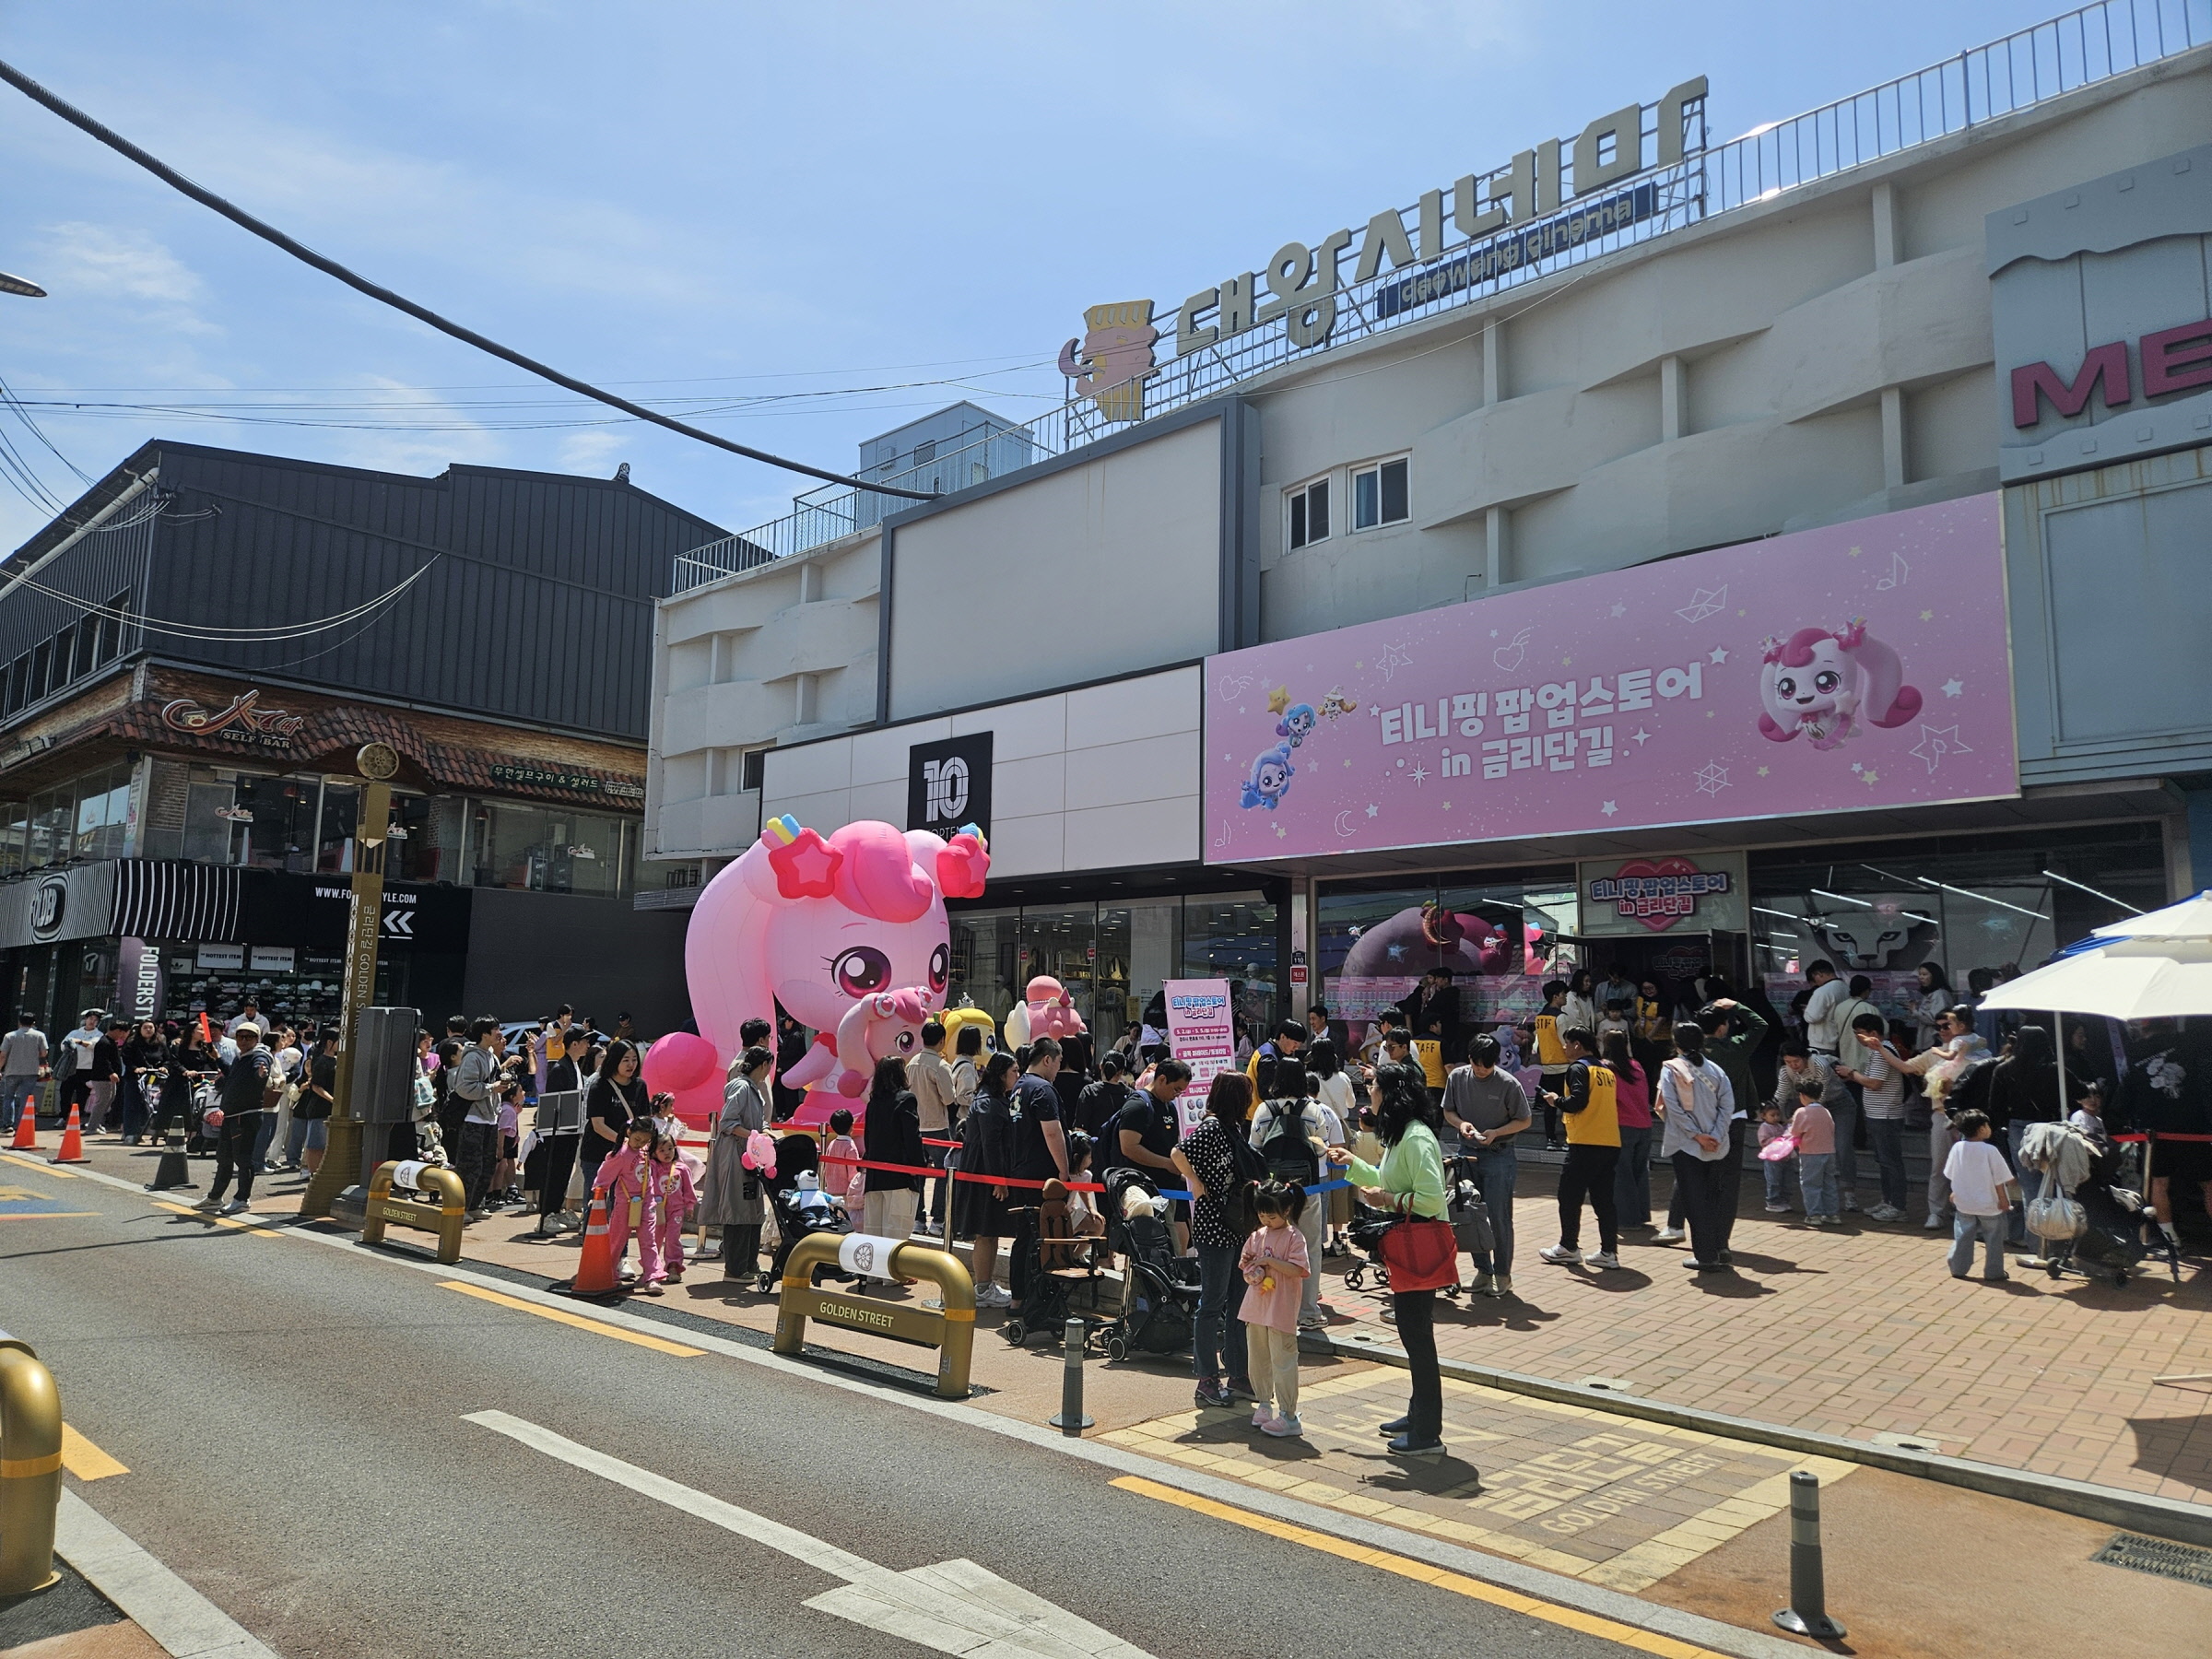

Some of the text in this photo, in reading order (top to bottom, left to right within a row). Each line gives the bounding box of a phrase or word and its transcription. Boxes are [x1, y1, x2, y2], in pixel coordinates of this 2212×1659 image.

[1381, 662, 1703, 746] 티니핑 팝업스토어
[222, 732, 291, 748] SELF BAR
[1441, 725, 1615, 780] in 금리단길
[924, 756, 969, 823] 10
[1592, 874, 1725, 899] 티니핑 팝업스토어
[1619, 896, 1692, 915] in 금리단길
[360, 905, 376, 949] 금리단길
[358, 953, 371, 998] GOLDEN
[1416, 1042, 1435, 1053] TAFF
[382, 1206, 417, 1222] GOLDEN STREET
[819, 1301, 894, 1328] GOLDEN STREET
[1538, 1453, 1725, 1535] GOLDEN STREET
